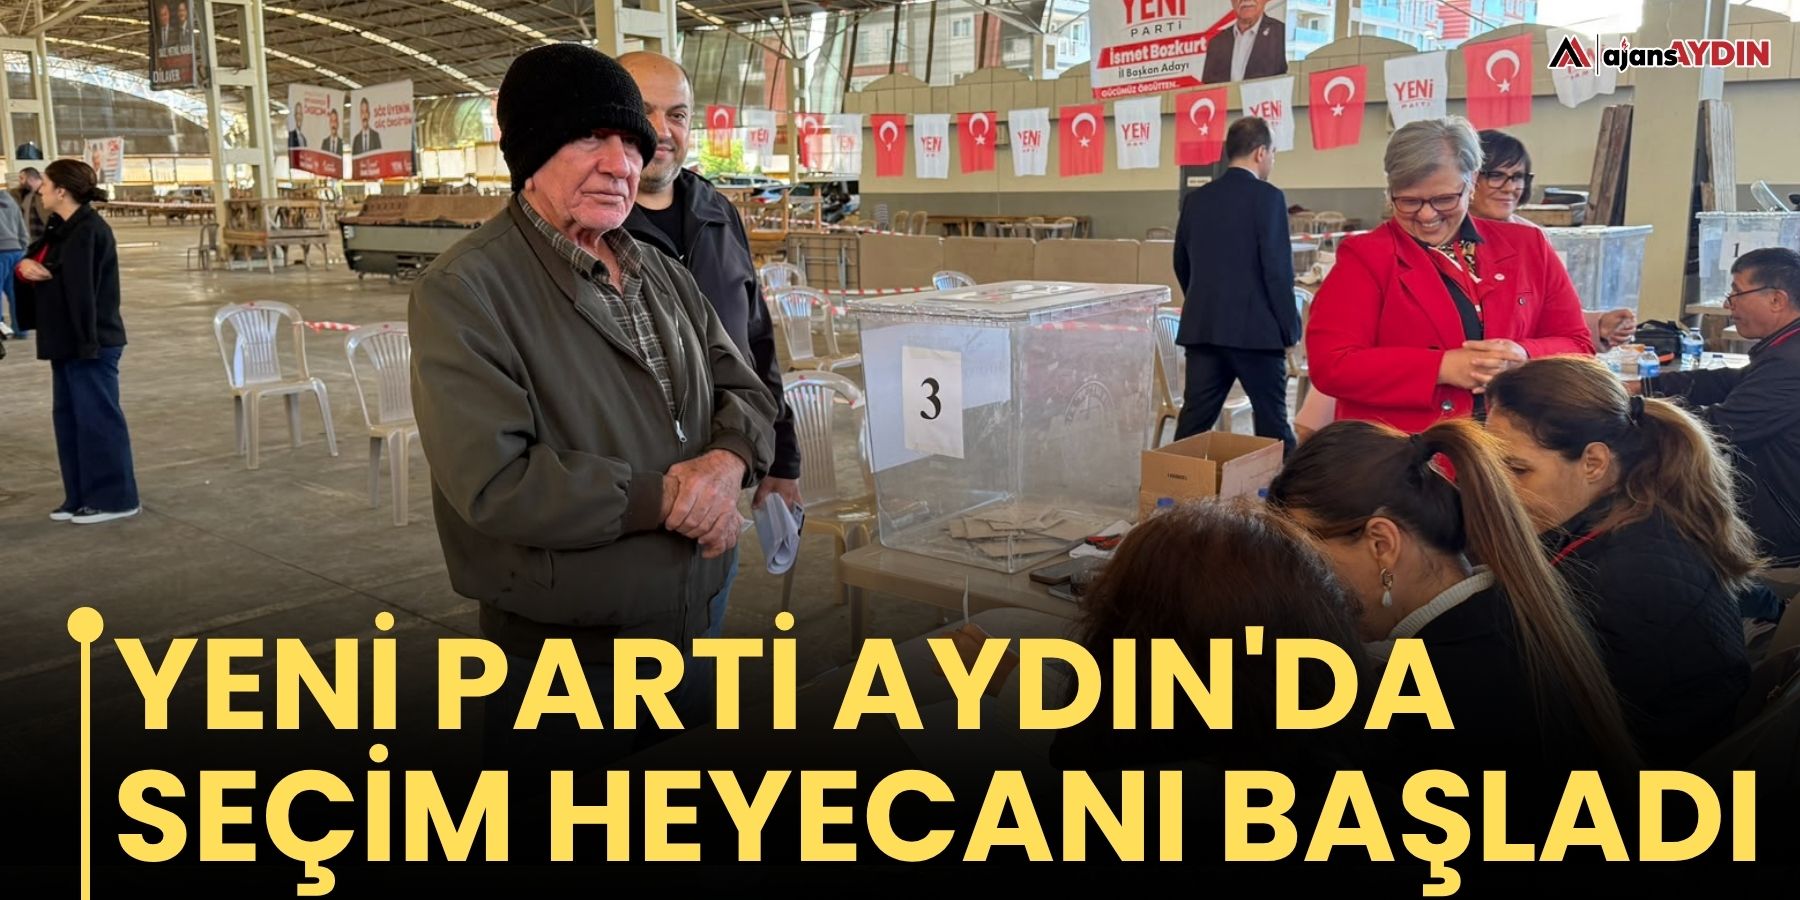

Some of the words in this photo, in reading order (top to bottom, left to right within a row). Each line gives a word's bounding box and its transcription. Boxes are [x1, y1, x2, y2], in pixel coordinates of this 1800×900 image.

[1110, 45, 1149, 65] İsmet
[1150, 37, 1207, 59] Bozkurt
[920, 377, 941, 420] 3
